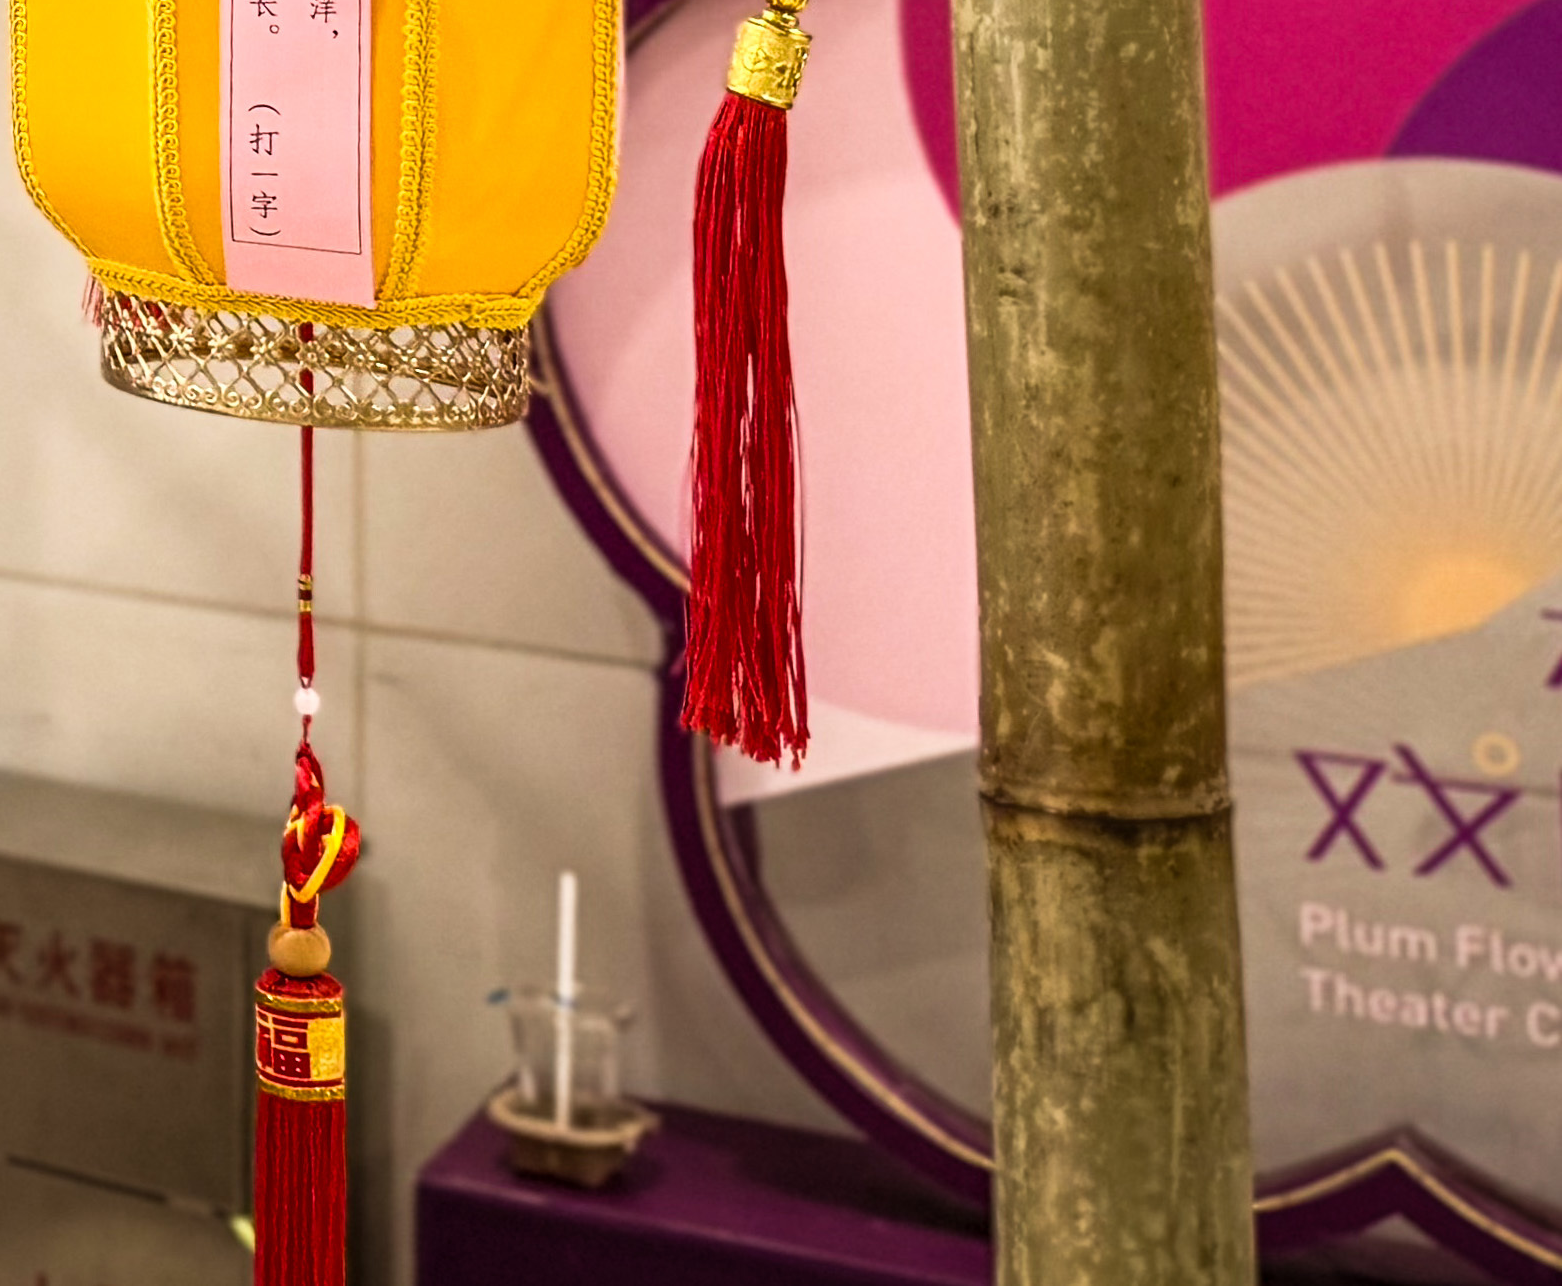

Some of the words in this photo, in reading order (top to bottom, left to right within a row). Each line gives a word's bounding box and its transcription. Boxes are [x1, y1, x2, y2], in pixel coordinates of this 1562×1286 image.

[248, 103, 282, 236] （打一字）
[1299, 900, 1439, 962] Plum
[1302, 968, 1509, 1039] Theater
